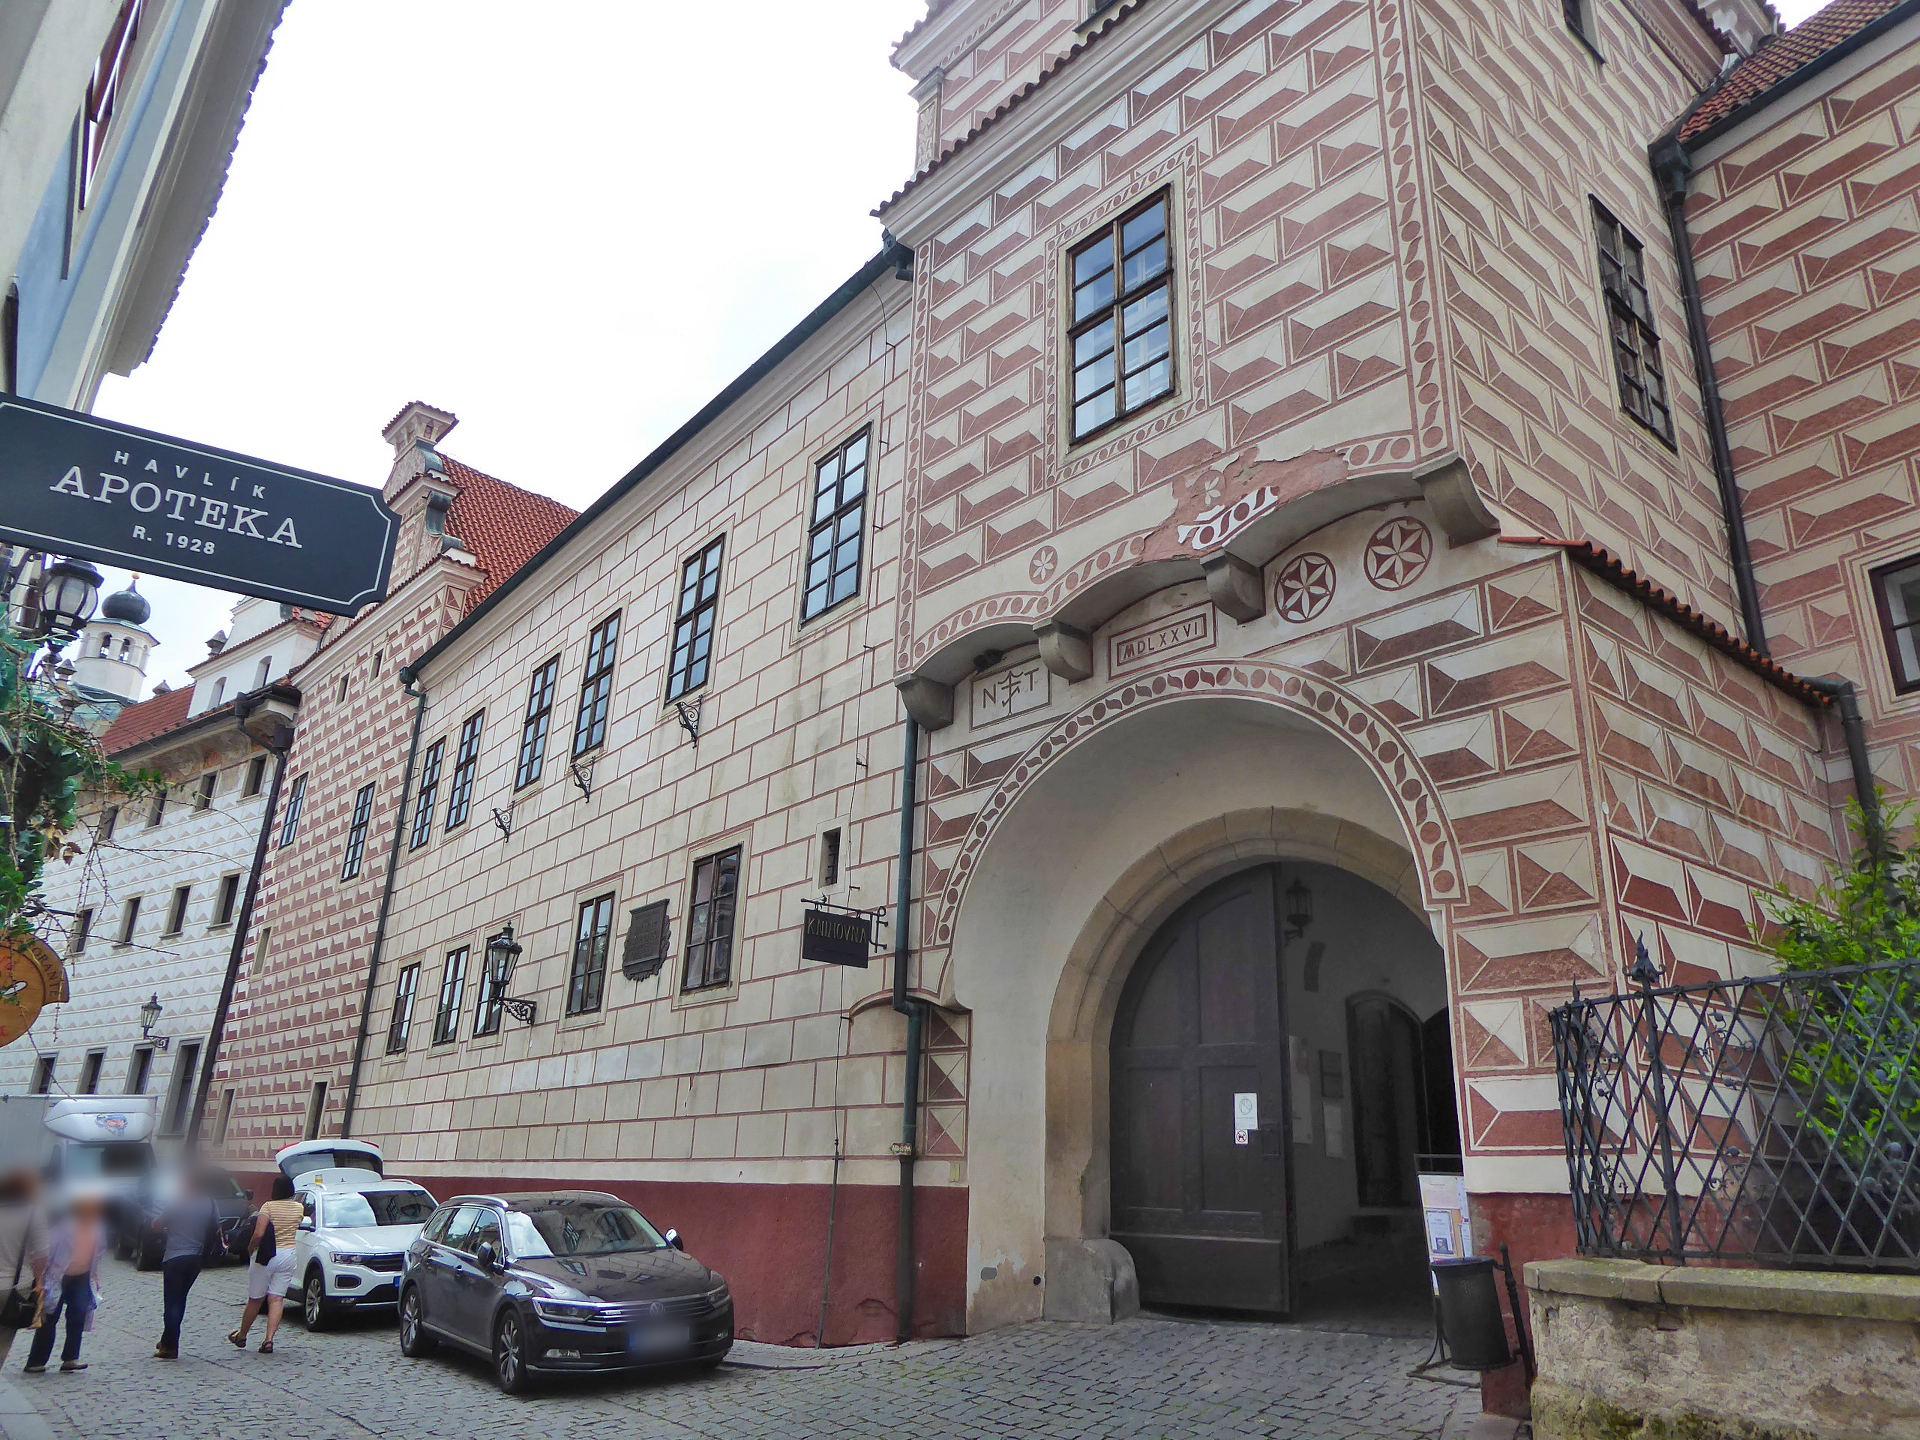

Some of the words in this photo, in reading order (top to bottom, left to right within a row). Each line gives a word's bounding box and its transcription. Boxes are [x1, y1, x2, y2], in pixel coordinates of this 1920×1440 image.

[114, 450, 265, 499] HAVLÍK
[49, 465, 303, 549] APOTEKA
[132, 525, 152, 541] R.
[165, 532, 215, 555] 1928
[807, 917, 867, 944] KNIHOVNA
